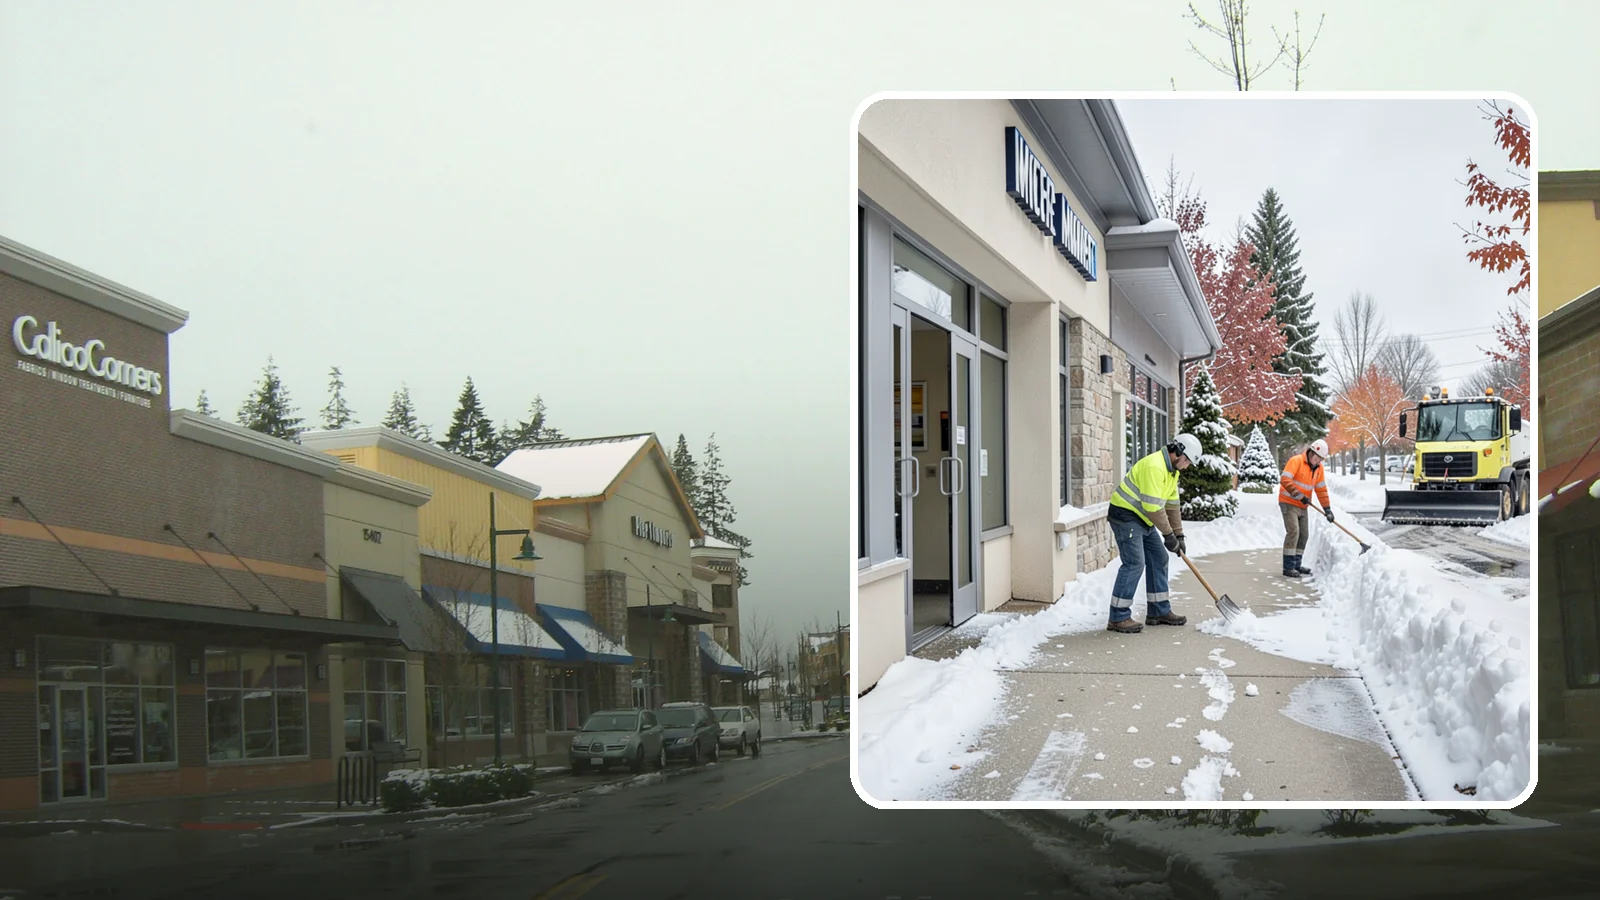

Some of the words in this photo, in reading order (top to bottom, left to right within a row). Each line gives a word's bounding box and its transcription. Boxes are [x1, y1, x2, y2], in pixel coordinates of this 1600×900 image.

[16, 360, 47, 377] FABRICS
[52, 370, 78, 386] WINDOW
[79, 379, 116, 398] TREATMENTS
[120, 391, 151, 408] FURNITURE
